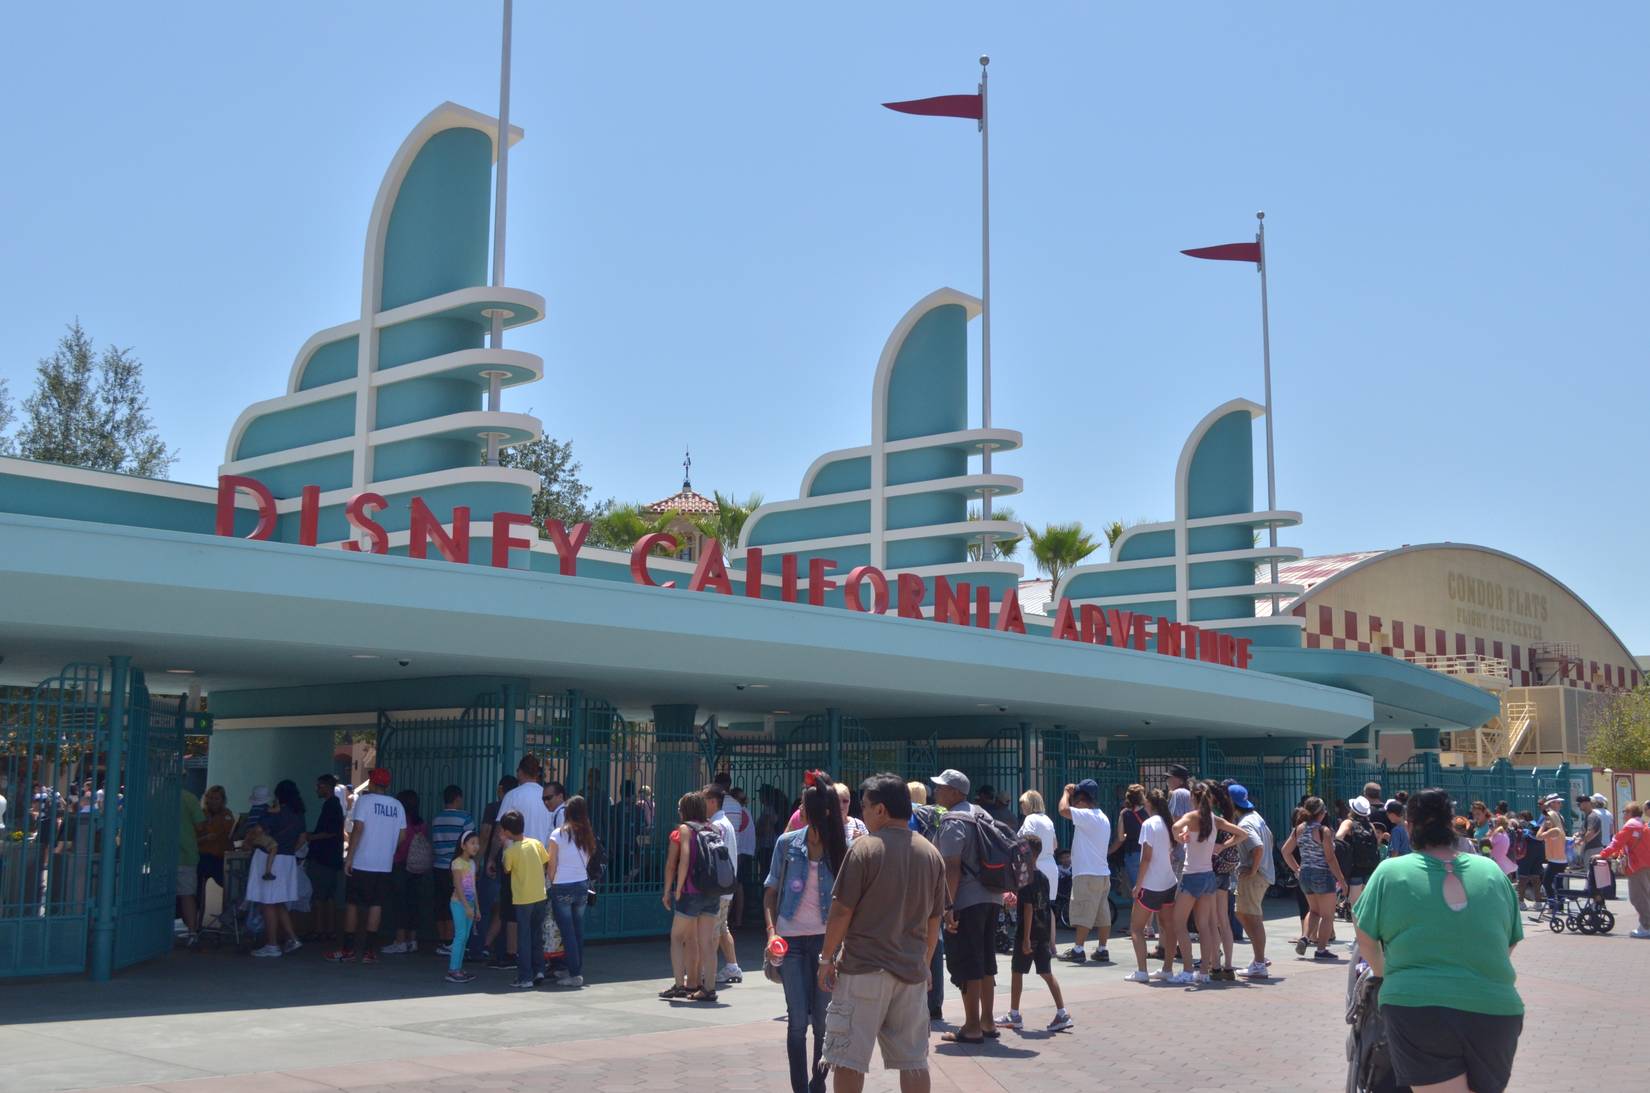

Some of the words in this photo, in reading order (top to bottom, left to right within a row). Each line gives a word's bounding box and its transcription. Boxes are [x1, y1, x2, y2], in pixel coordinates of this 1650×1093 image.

[216, 474, 591, 577] DISNEY
[1051, 596, 1254, 670] ADVENTURE
[1447, 570, 1504, 611] CONDOR
[1508, 586, 1548, 622] FLATS
[374, 802, 398, 818] ITALIA
